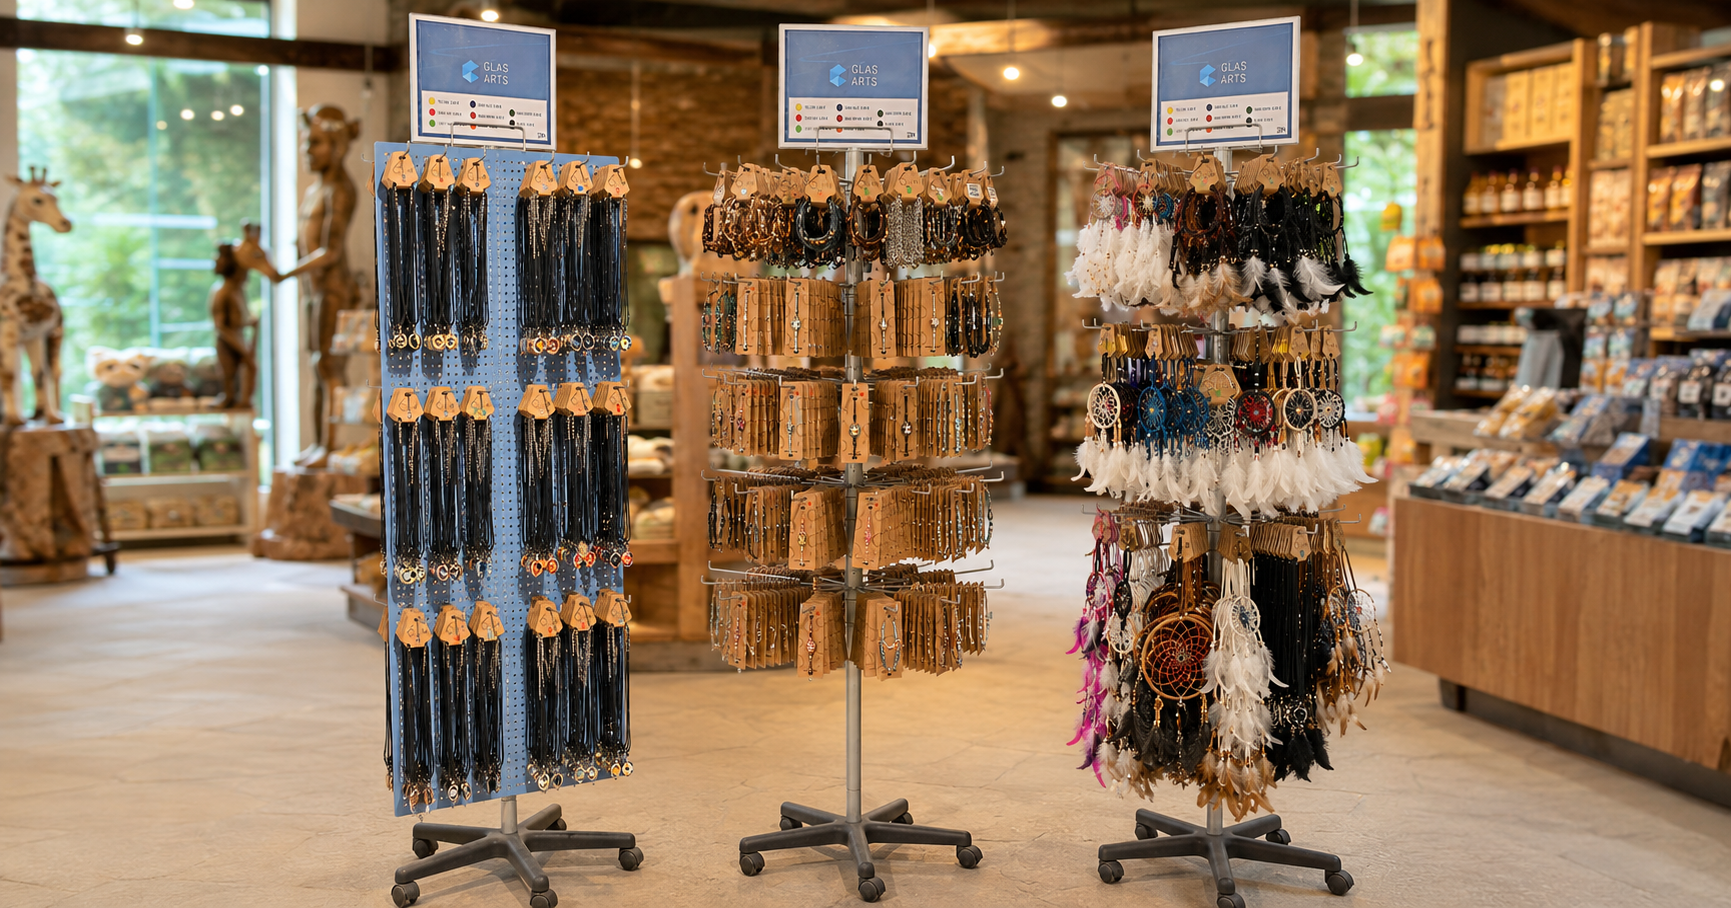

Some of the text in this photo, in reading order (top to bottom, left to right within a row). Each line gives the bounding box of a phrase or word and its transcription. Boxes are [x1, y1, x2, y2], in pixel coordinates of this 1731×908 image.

[483, 61, 509, 73] GLAS
[851, 64, 878, 75] GLAS
[1221, 60, 1247, 72] GLAS
[483, 74, 509, 85] ARTS
[851, 76, 878, 87] ARTS
[1220, 73, 1247, 84] ARTS
